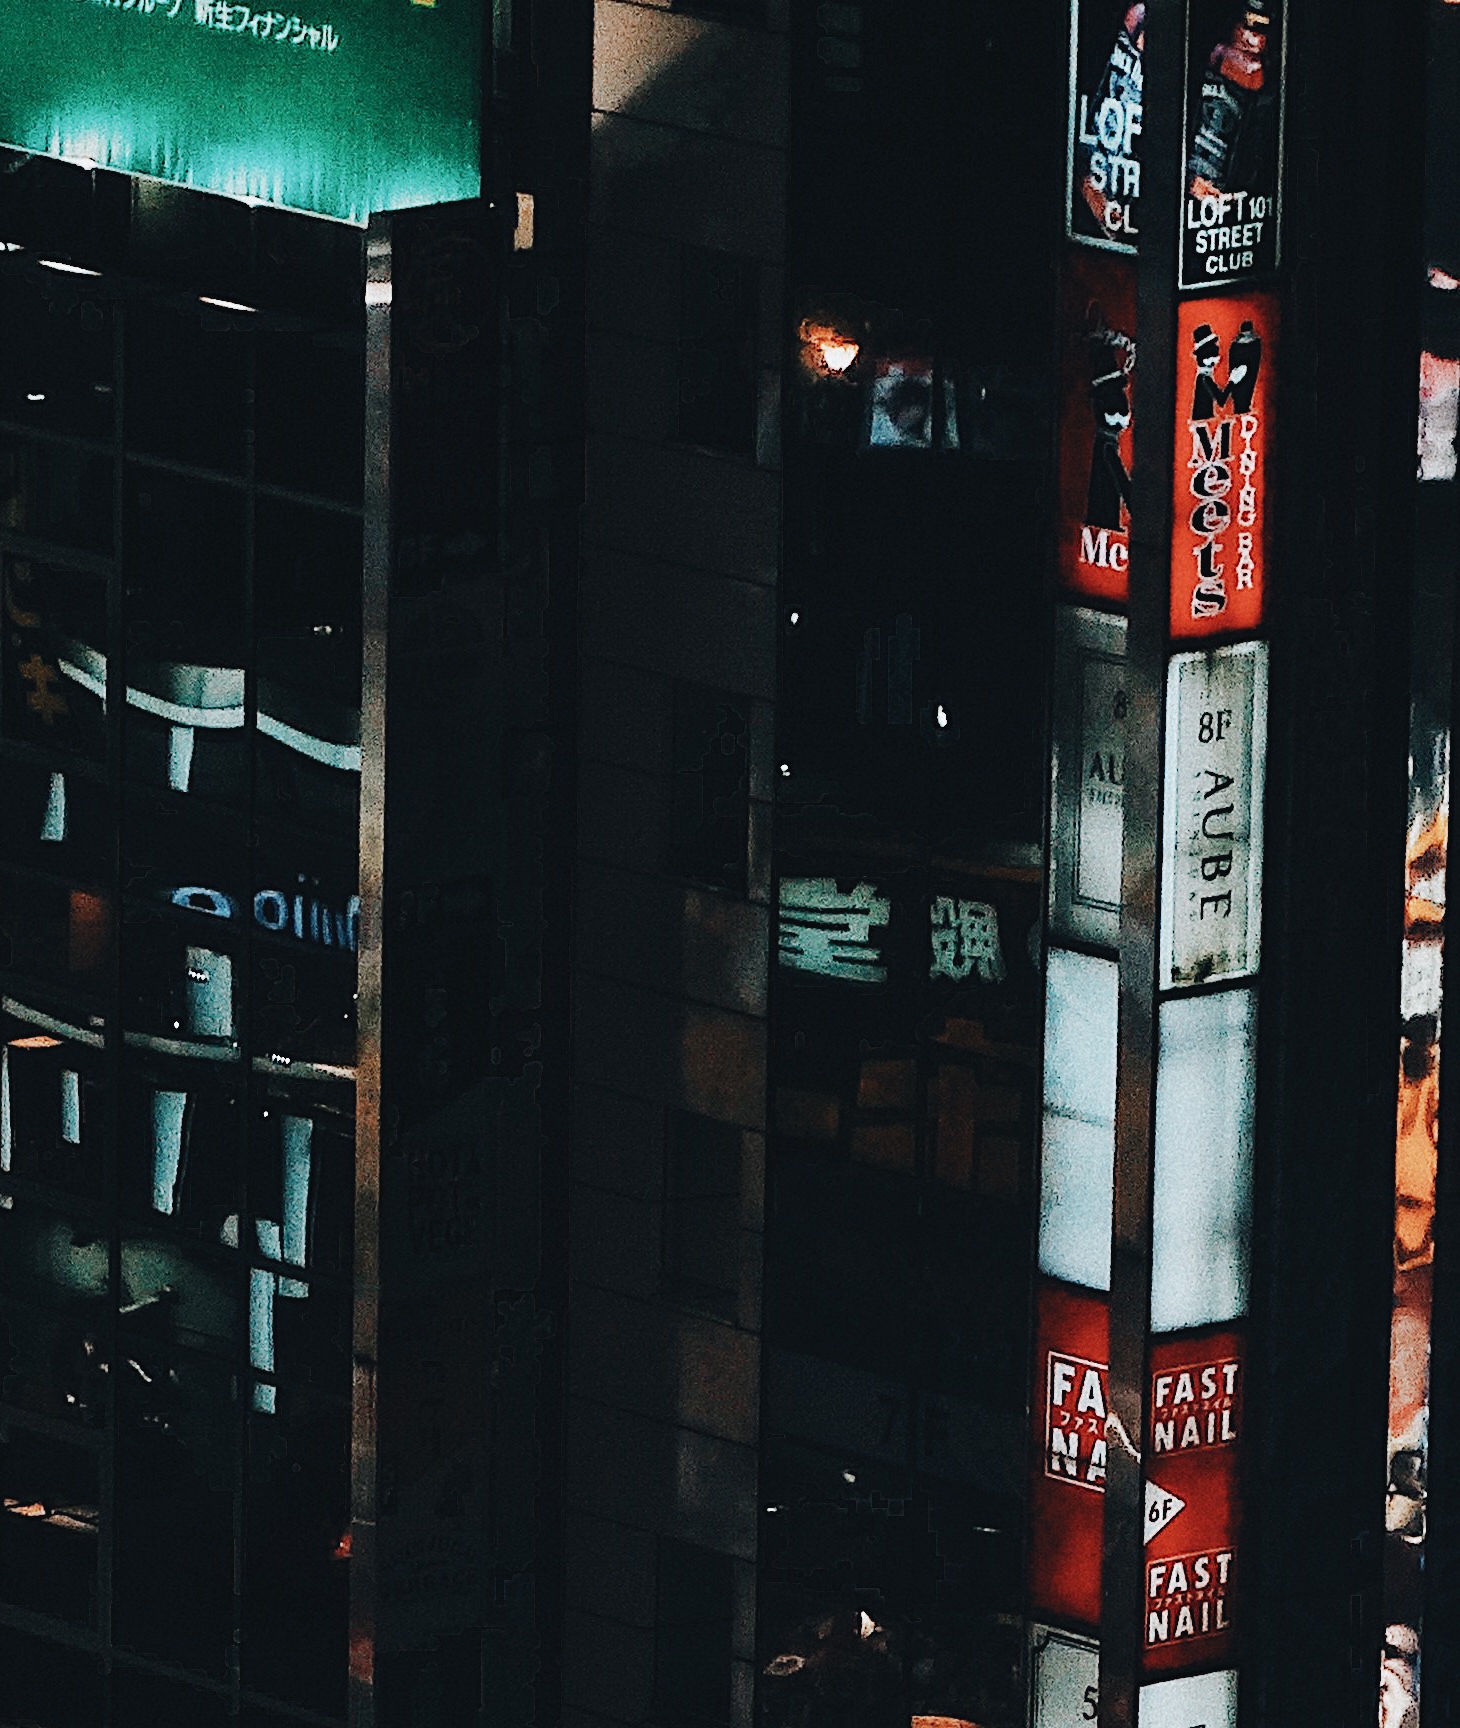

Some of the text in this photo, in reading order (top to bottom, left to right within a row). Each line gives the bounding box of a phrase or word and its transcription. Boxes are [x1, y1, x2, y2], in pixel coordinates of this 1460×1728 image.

[1187, 191, 1248, 229] LOFT
[1196, 221, 1264, 254] STREET
[1205, 250, 1254, 274] CLUB
[1188, 417, 1232, 621] Meets
[1236, 530, 1255, 590] BAR
[1198, 708, 1233, 744] 8F
[1199, 769, 1234, 920] AUBE
[1156, 1363, 1239, 1408] FAST
[1154, 1409, 1237, 1453] NAIL
[1148, 1498, 1173, 1523] 6F
[1149, 1553, 1232, 1598] FAST
[1148, 1600, 1230, 1643] NAIL
